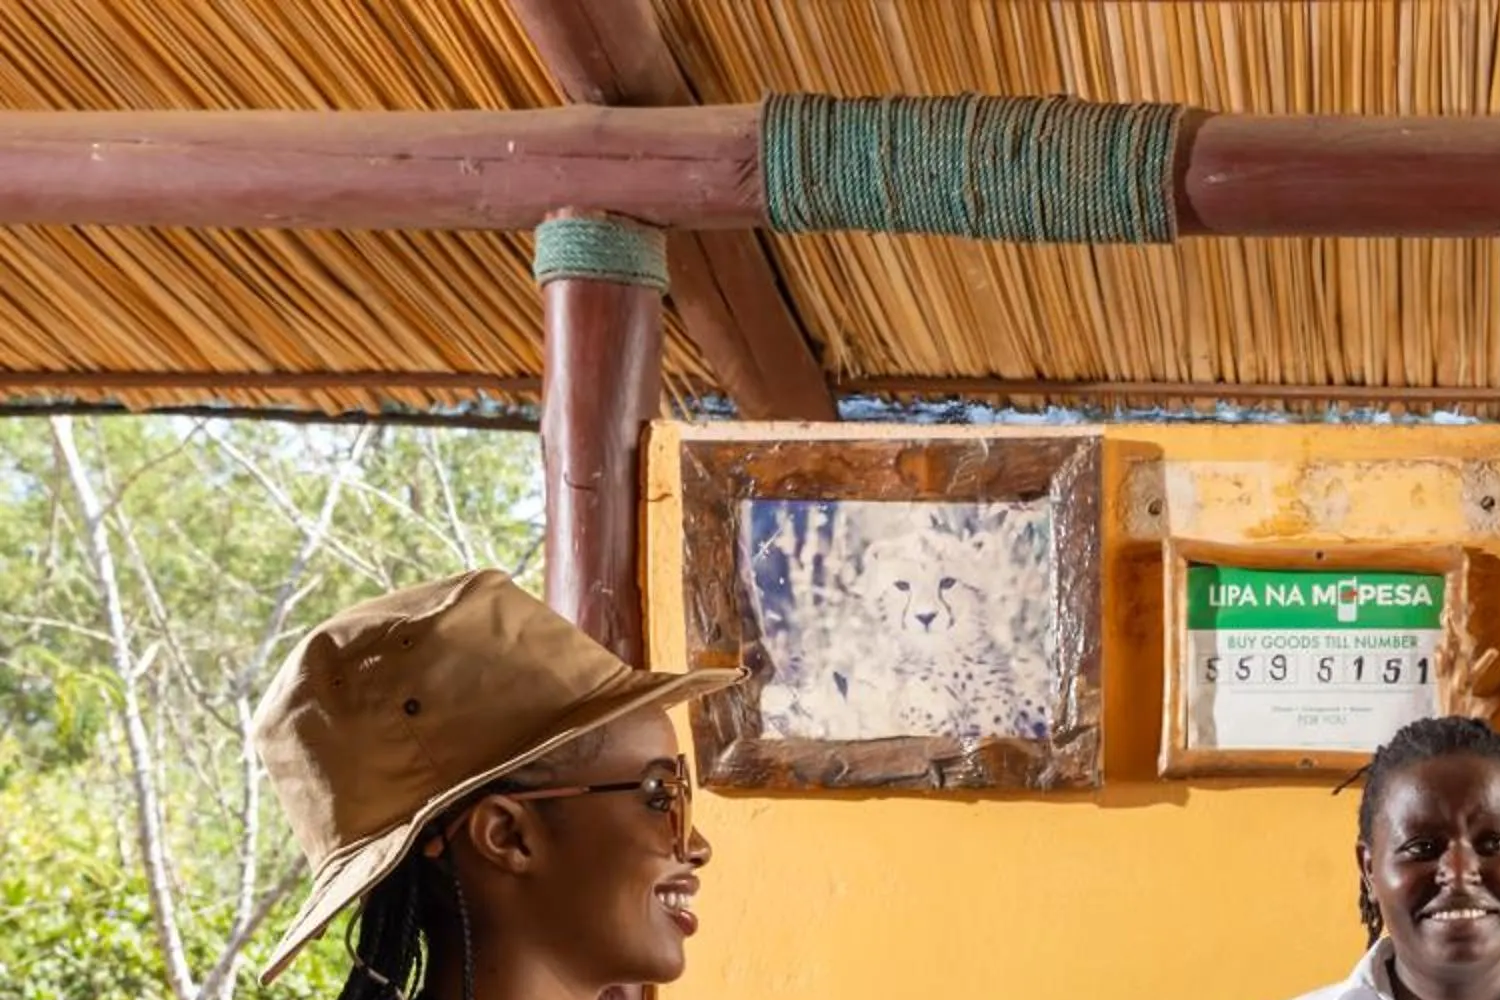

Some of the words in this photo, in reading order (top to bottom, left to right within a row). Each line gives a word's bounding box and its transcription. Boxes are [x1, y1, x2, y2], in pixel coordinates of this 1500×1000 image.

[1209, 584, 1258, 606] LIPA
[1265, 584, 1305, 606] NA
[1227, 635, 1256, 649] BUY
[1261, 635, 1320, 649] GOODS
[1325, 635, 1349, 649] TILL
[1355, 635, 1418, 649] NUMBER
